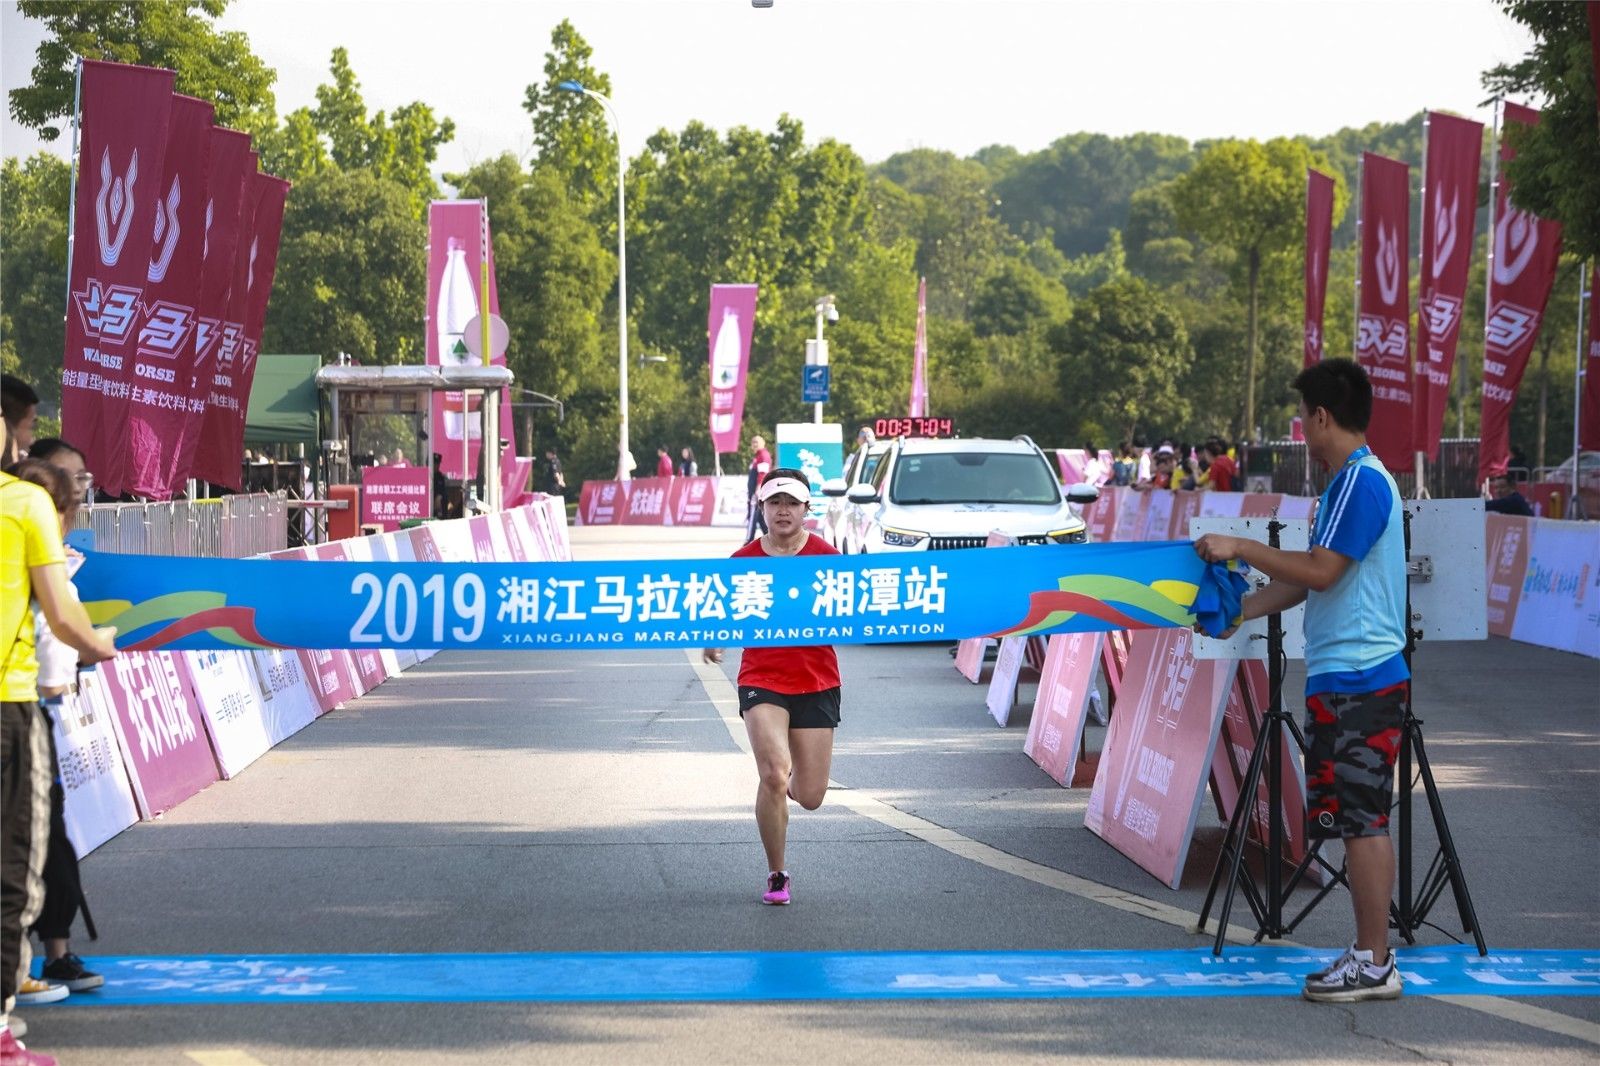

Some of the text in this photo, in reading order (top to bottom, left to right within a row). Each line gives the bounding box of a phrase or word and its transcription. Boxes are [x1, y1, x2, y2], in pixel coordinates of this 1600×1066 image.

[876, 419, 952, 436] 00:37:04
[371, 501, 420, 514] 联席会议
[349, 572, 486, 643] 2019
[502, 623, 945, 644] XIANGJIANG MARATHON XIANGTAN STATION
